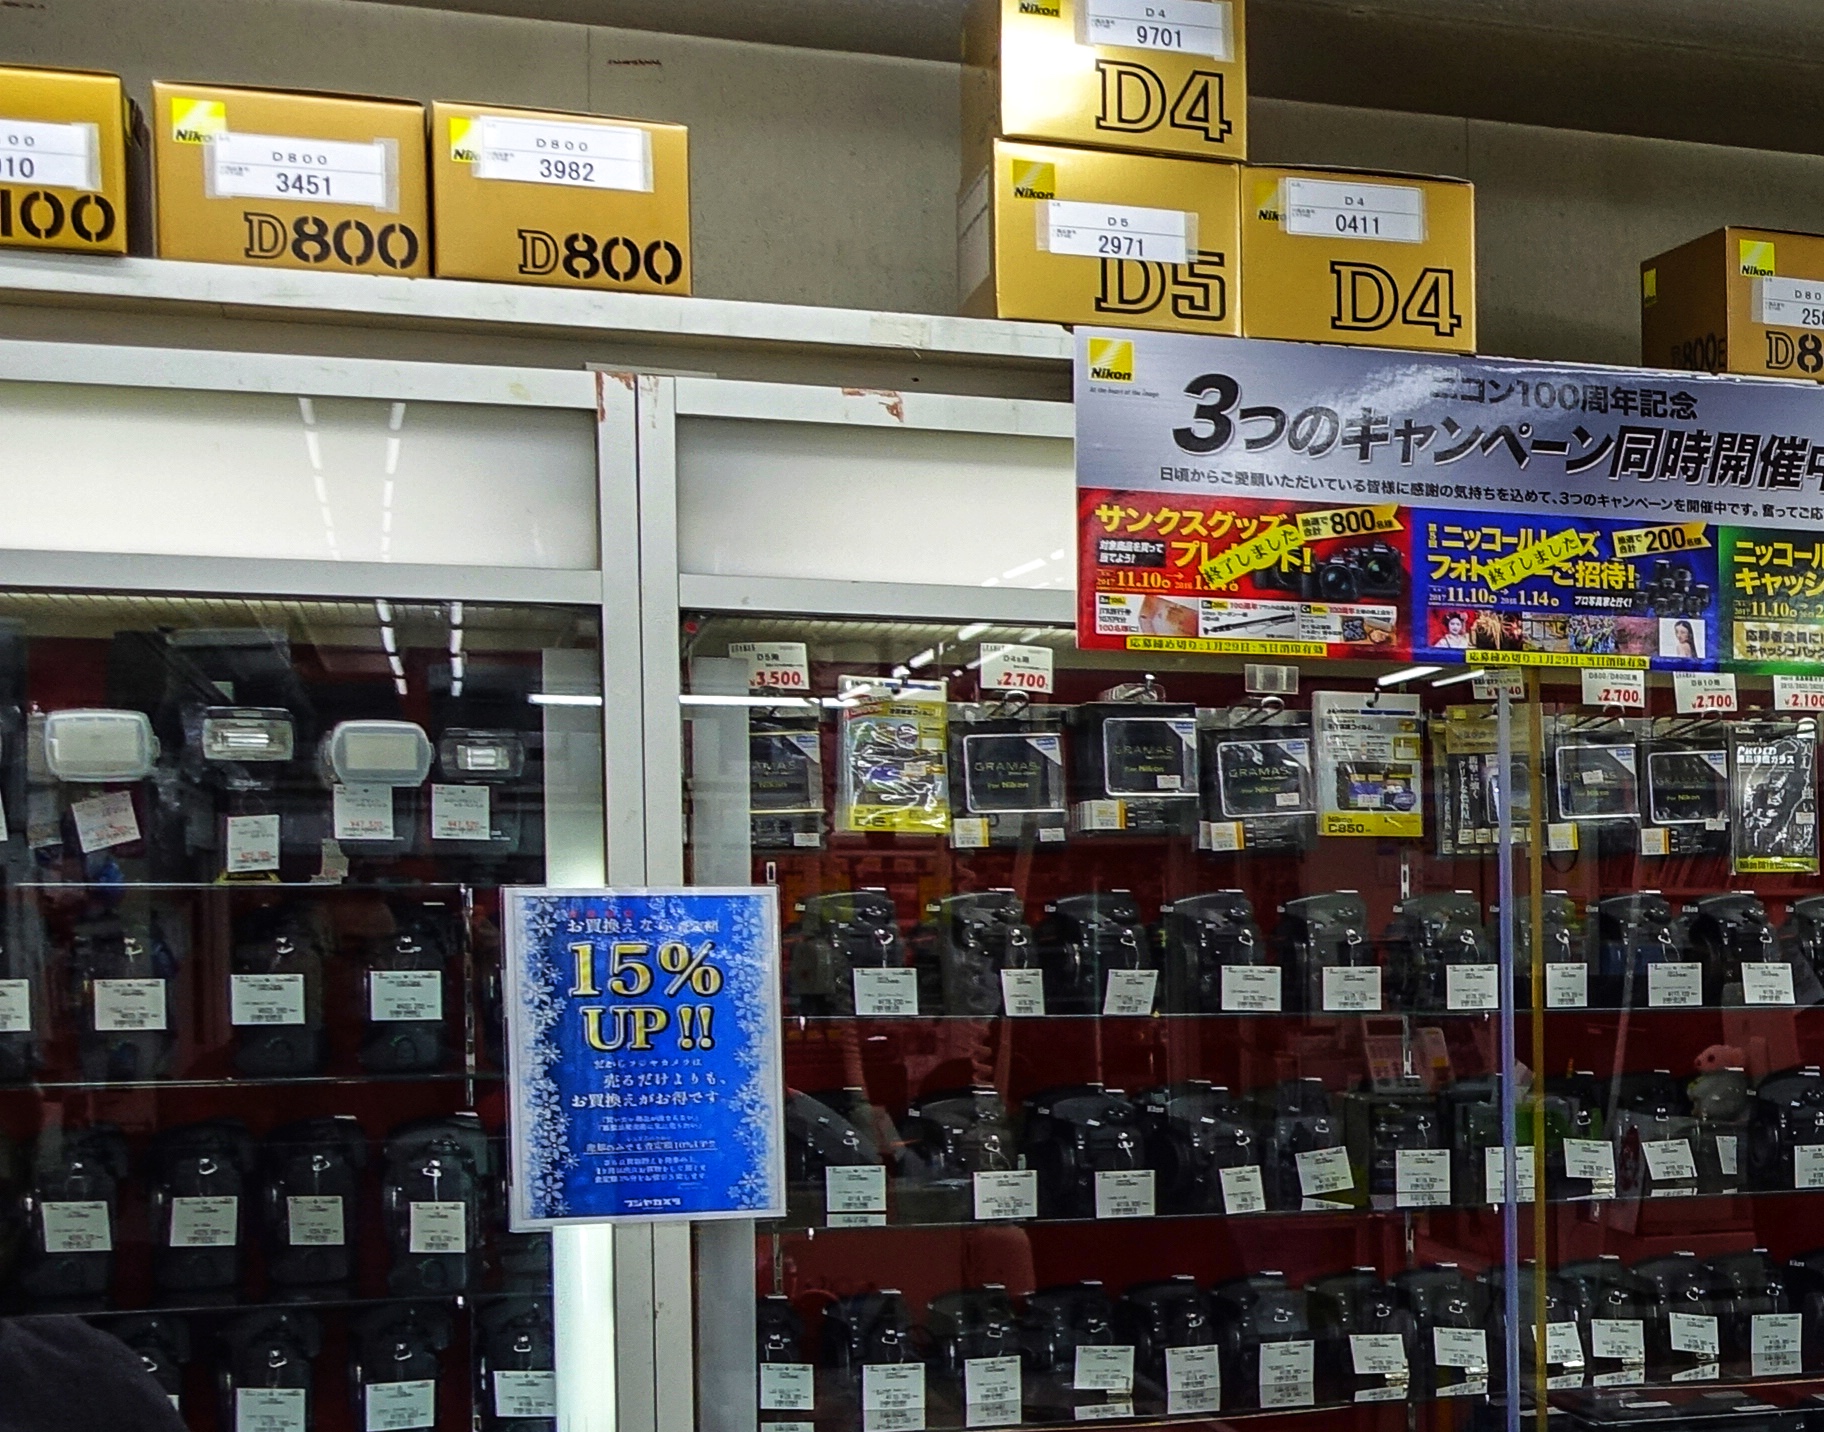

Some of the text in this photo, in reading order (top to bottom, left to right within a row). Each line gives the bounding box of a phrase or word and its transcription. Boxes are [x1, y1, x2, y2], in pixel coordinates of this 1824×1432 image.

[1018, 2, 1060, 17] Nikon
[1143, 8, 1167, 18] D4
[1135, 26, 1183, 48] 9701
[1095, 59, 1231, 142] D4
[535, 138, 589, 152] D800
[271, 151, 328, 165] D800
[538, 159, 594, 183] 3982
[275, 172, 332, 196] 3451
[1013, 186, 1055, 199] Nikon
[1344, 196, 1365, 206] D4
[1106, 217, 1129, 226] D5
[1334, 214, 1380, 235] 0411
[243, 211, 419, 270] D800
[1097, 235, 1144, 256] 2971
[517, 229, 682, 286] D800
[1740, 265, 1774, 277] Nikon
[1094, 250, 1226, 320] D5
[1329, 260, 1462, 336] D4
[1089, 368, 1132, 381] Nikon
[1432, 372, 1698, 421] ニコン100周年記念
[1201, 525, 1299, 585] 終了しました
[1485, 536, 1580, 583] 終了しました
[567, 940, 724, 998] 15%
[580, 1004, 716, 1050] UP!!
